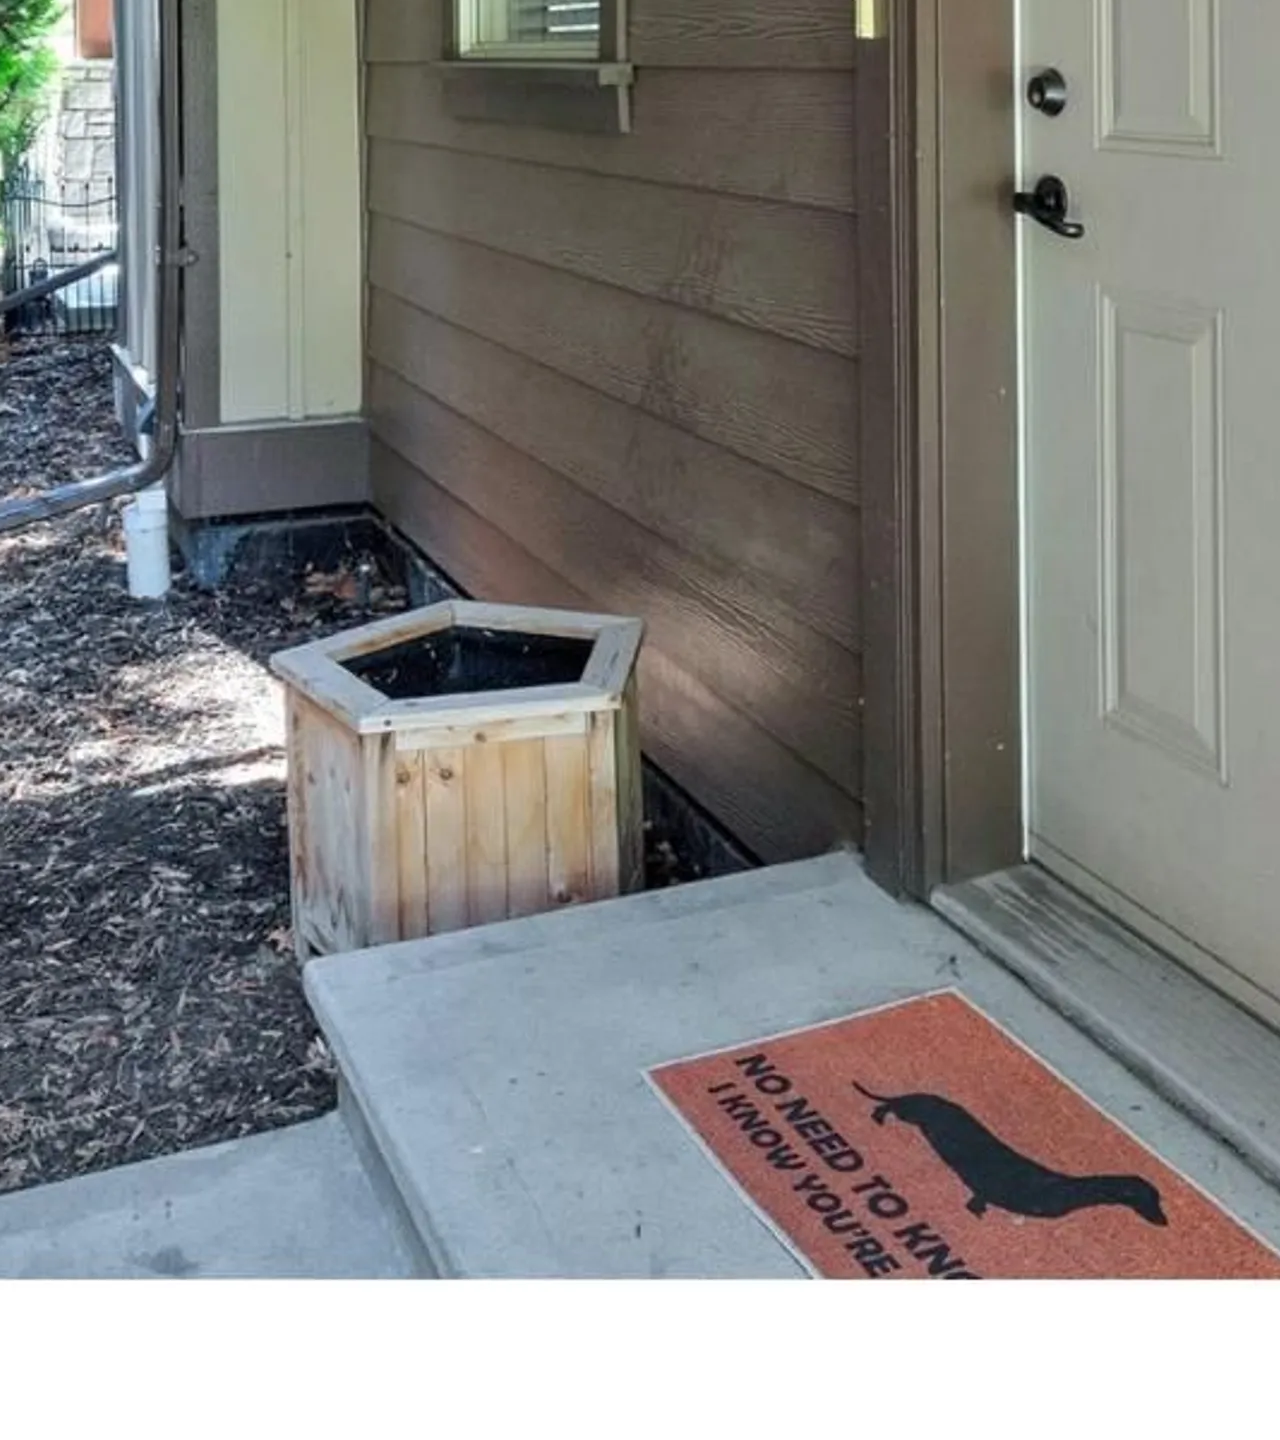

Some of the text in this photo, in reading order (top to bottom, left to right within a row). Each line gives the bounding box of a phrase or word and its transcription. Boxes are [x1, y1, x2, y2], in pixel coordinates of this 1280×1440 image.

[709, 1082, 903, 1278] I KNOW YOU'RE
[737, 1054, 791, 1094] NO
[776, 1098, 863, 1172] NEED
[851, 1174, 909, 1219] TO
